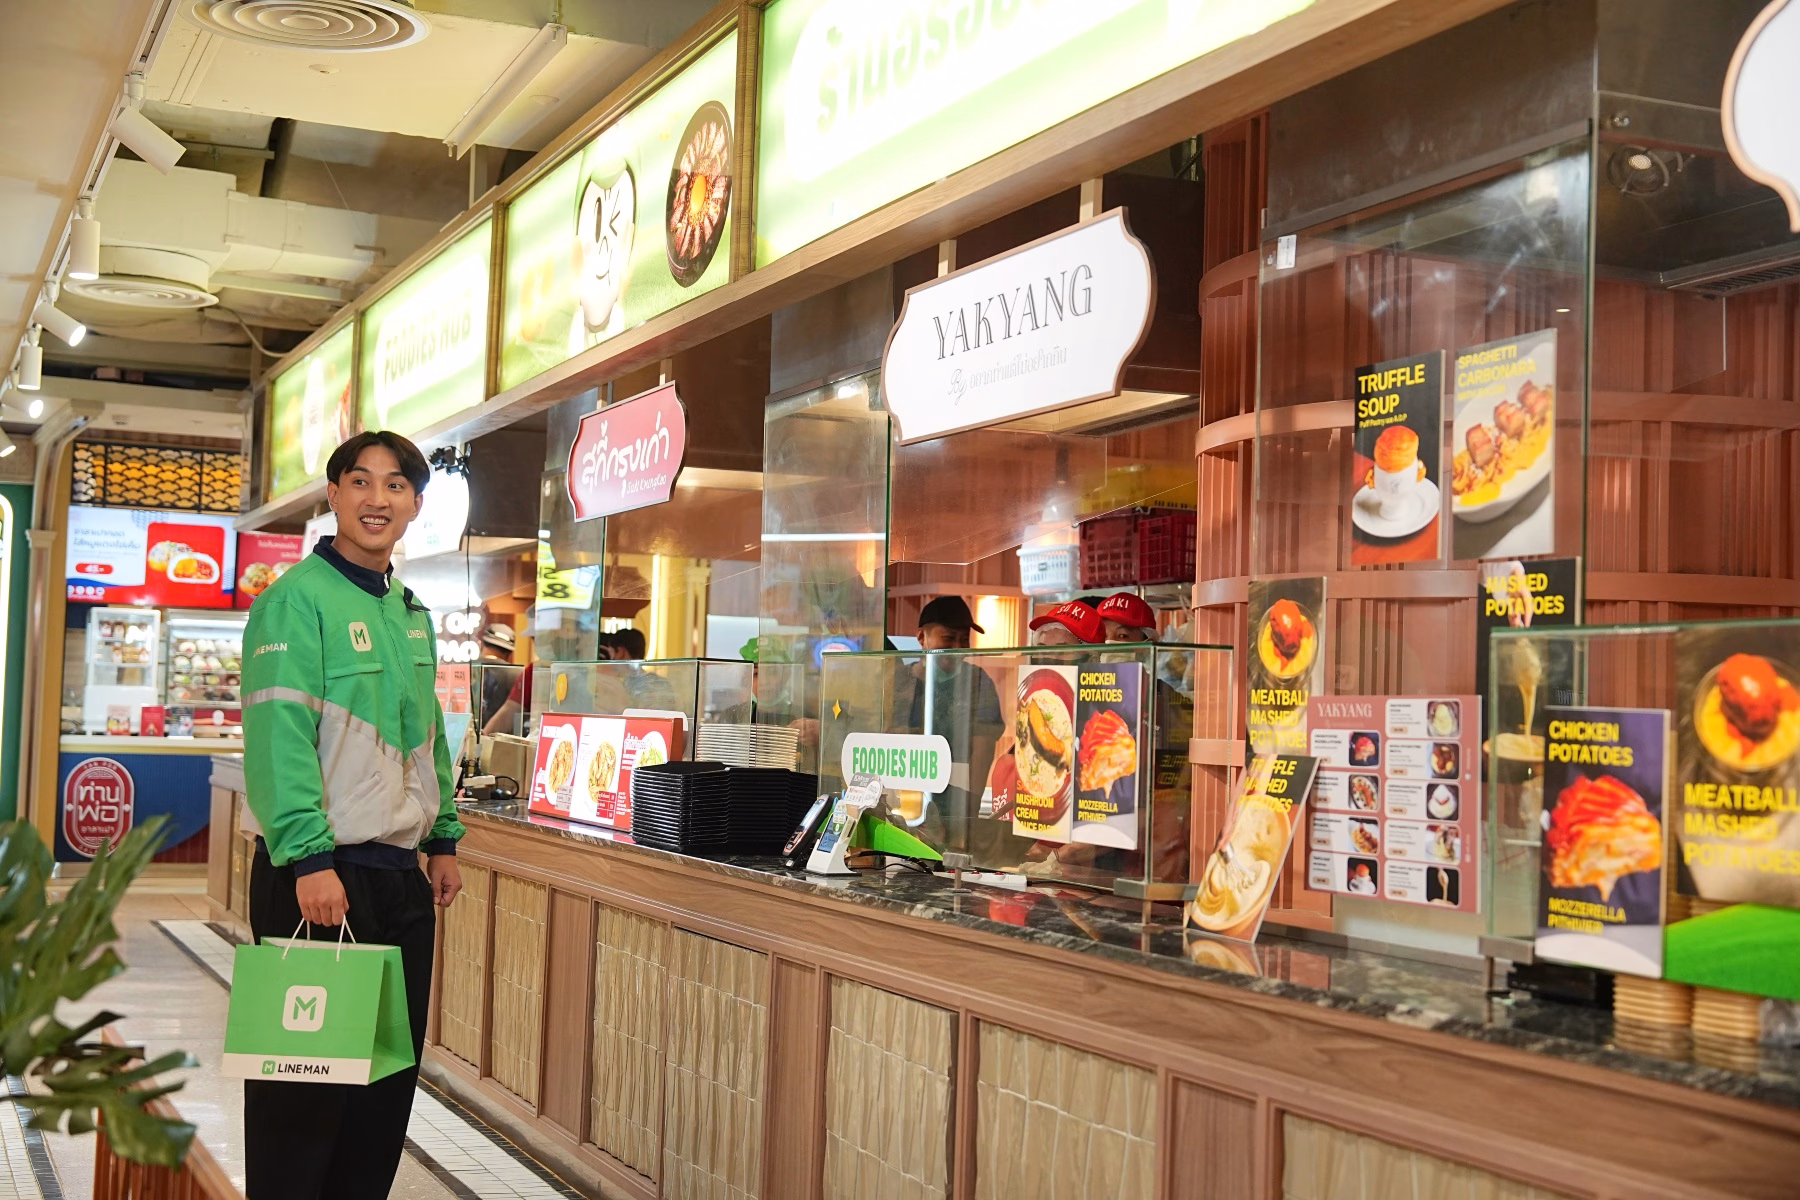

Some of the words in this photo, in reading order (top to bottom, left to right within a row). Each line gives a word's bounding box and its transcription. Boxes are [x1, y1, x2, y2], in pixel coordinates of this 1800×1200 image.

[932, 264, 1094, 361] YAKYANG
[384, 310, 437, 389] FOODIES
[440, 292, 472, 354] HUB
[1457, 345, 1518, 369] SPAGHETTI
[1358, 364, 1426, 394] TRUFFLE
[1457, 360, 1536, 388] CARBONARA
[1358, 394, 1400, 418] SOUP
[581, 411, 670, 498] สุกี้กรุงเก่า
[1485, 573, 1548, 594] MASHED
[1485, 595, 1565, 617] POTATOES
[353, 628, 367, 645] M
[1080, 672, 1116, 686] CHICKEN
[1079, 689, 1122, 702] POTATOES
[1250, 709, 1299, 726] MASHED
[1317, 703, 1372, 718] YAKYANG
[1549, 720, 1620, 742] CHICKEN
[852, 746, 907, 778] FOODIES
[909, 749, 939, 780] HUB
[1549, 743, 1634, 767] POTATOES
[1251, 758, 1298, 775] TRUFFLE
[79, 781, 120, 803] ท่าน
[1244, 776, 1288, 794] MASHED
[1016, 793, 1054, 808] MUSHROOM
[1078, 799, 1119, 813] MOZZERELLA
[1684, 782, 1800, 813] MEATBALL
[78, 800, 119, 822] พ่อ
[1016, 806, 1039, 820] CREAM
[1684, 812, 1778, 841] MASHED
[1684, 842, 1800, 875] POTATOES
[293, 995, 317, 1021] M
